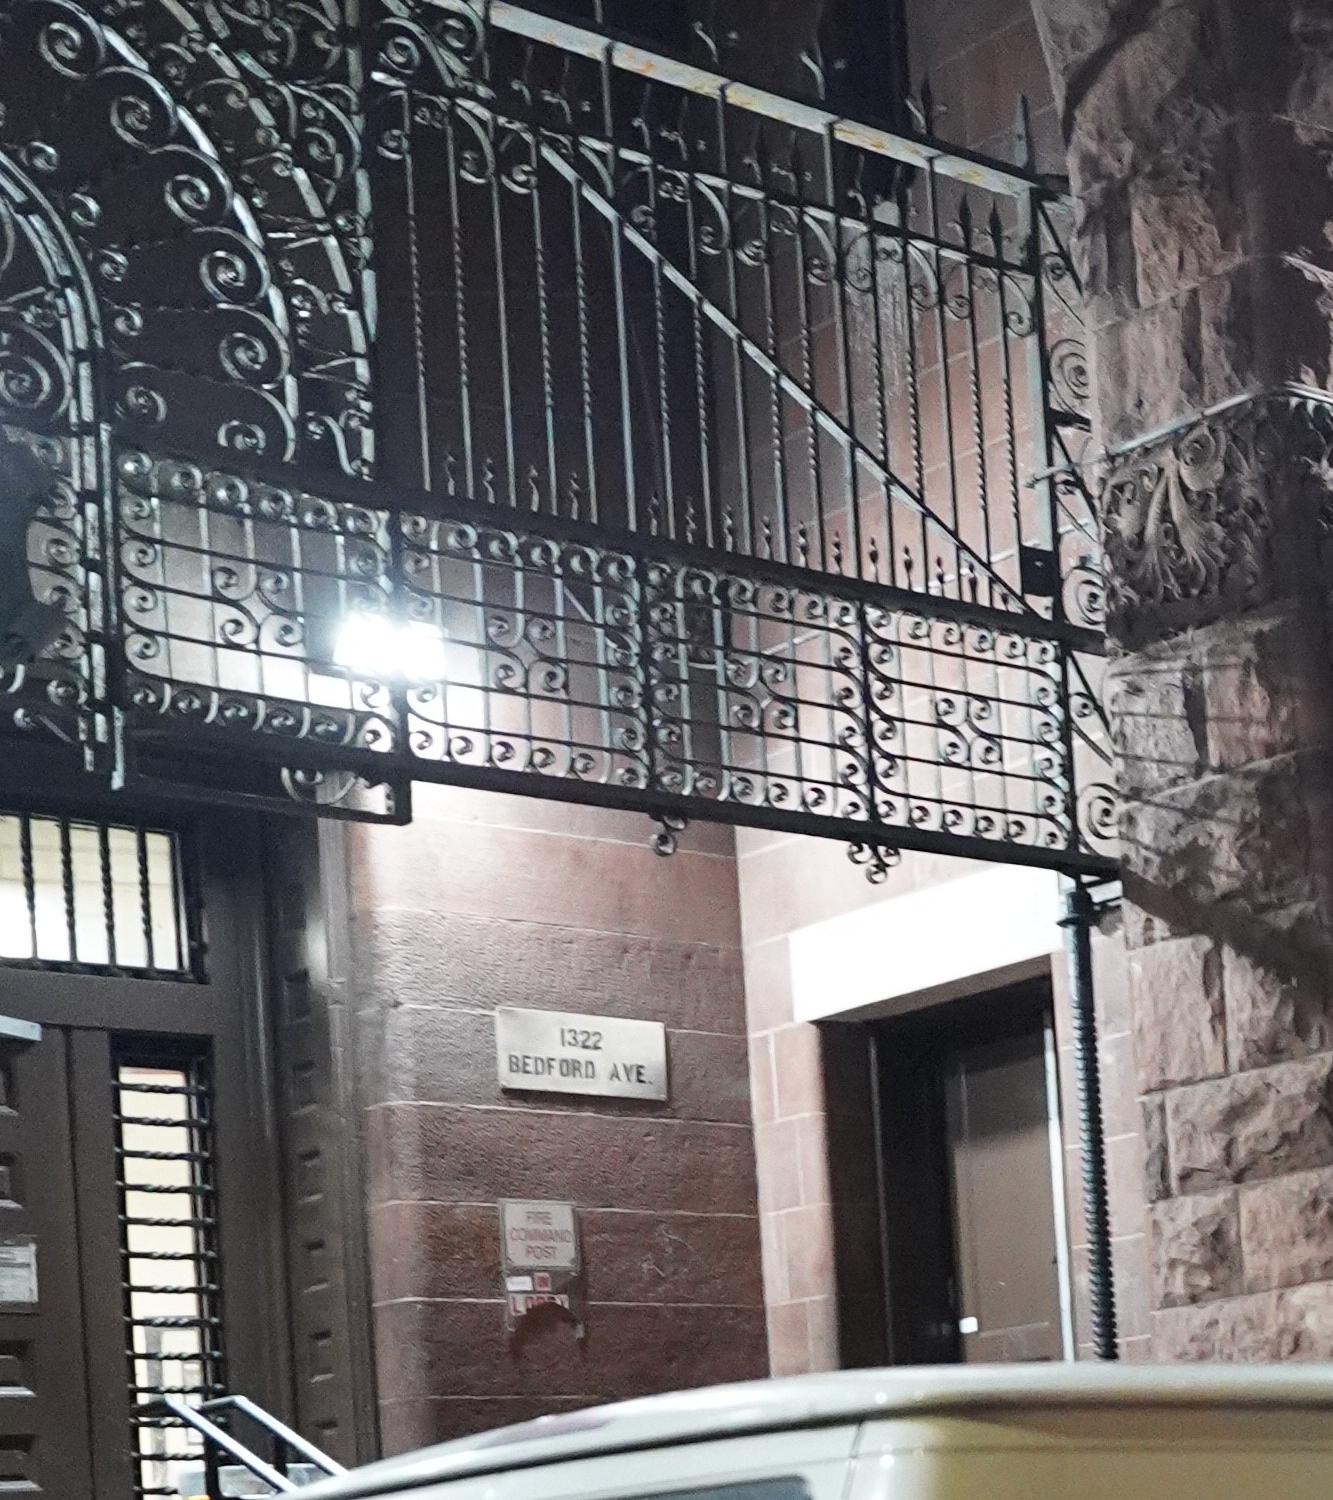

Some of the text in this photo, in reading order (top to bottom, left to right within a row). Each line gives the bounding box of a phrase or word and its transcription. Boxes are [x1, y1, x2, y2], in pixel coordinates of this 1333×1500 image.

[559, 1026, 604, 1051] 1322
[508, 1054, 654, 1086] BEDFORD AVE.
[510, 1227, 573, 1244] COMMAND
[525, 1244, 558, 1261] POST
